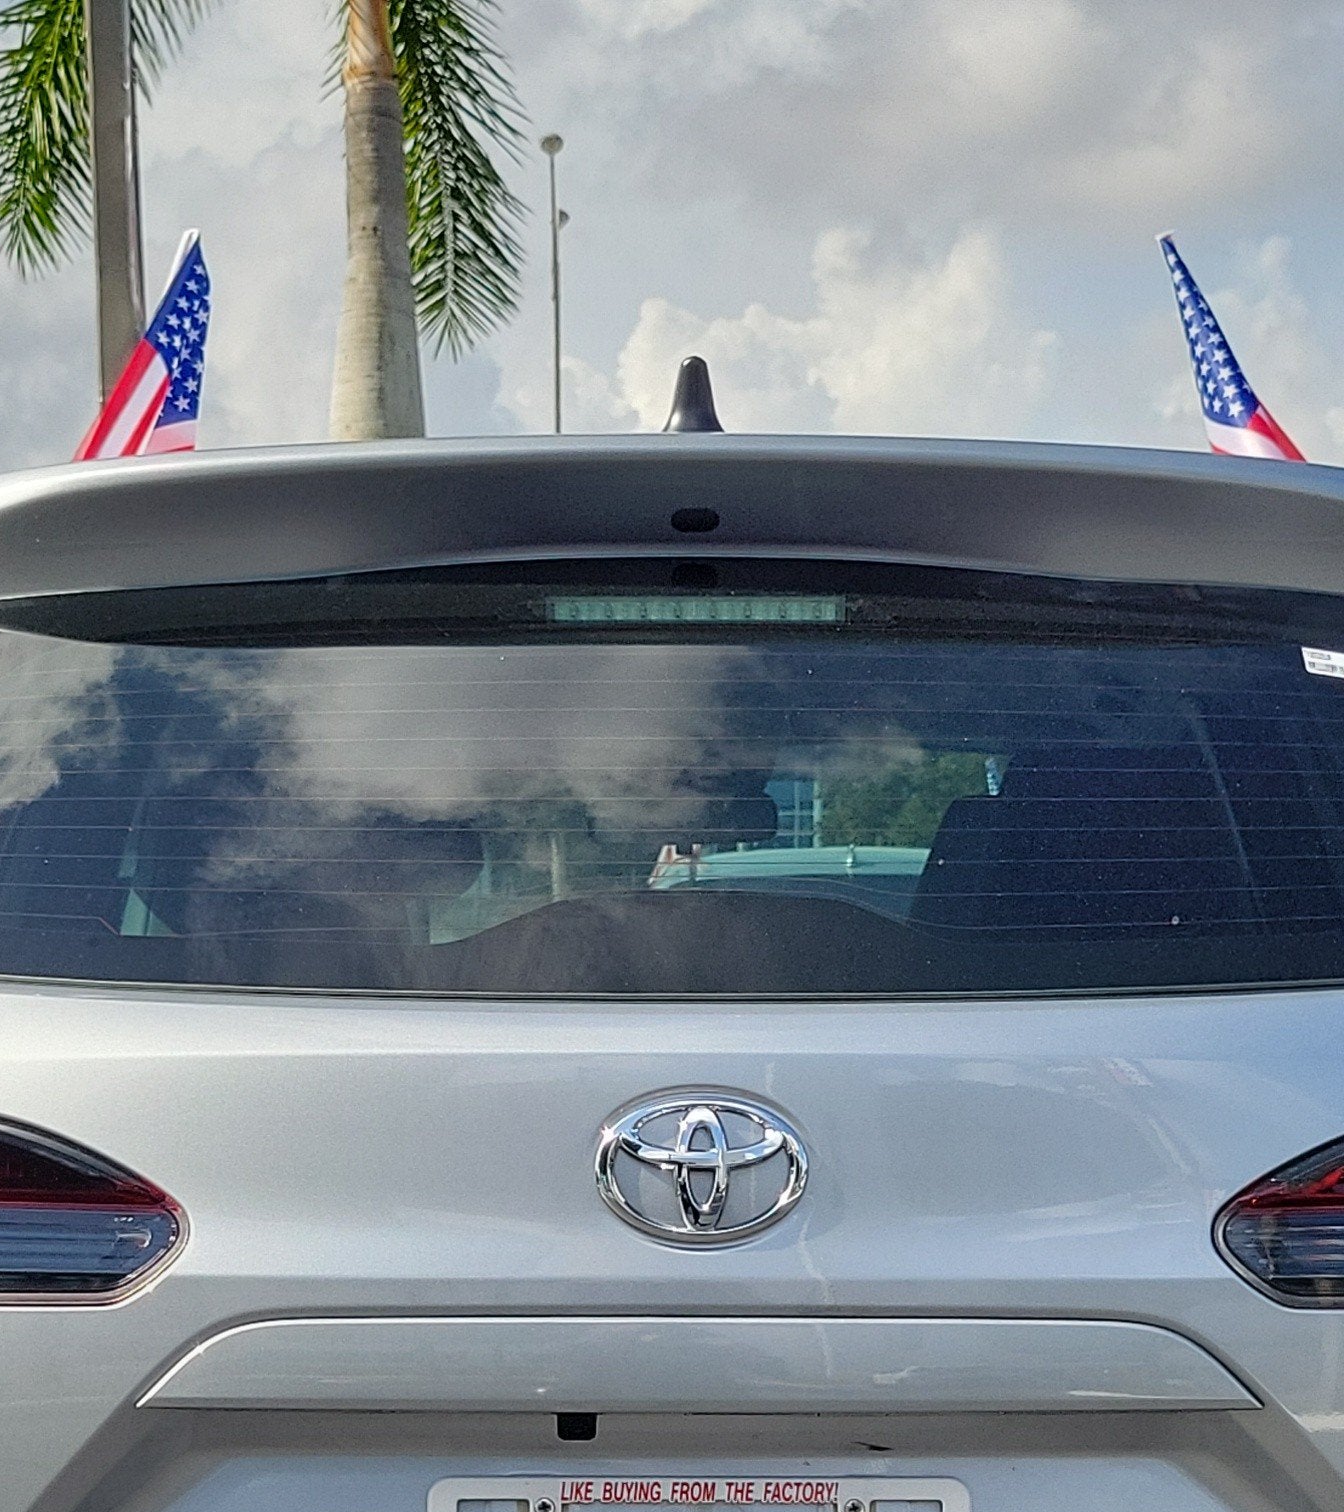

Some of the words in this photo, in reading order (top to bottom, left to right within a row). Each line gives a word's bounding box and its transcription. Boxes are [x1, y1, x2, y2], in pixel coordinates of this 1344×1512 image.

[560, 1481, 594, 1501] LIKE
[601, 1481, 662, 1502] BUYING
[670, 1481, 716, 1503] FROM
[726, 1481, 755, 1502] THE
[762, 1481, 839, 1503] FACTORY!
